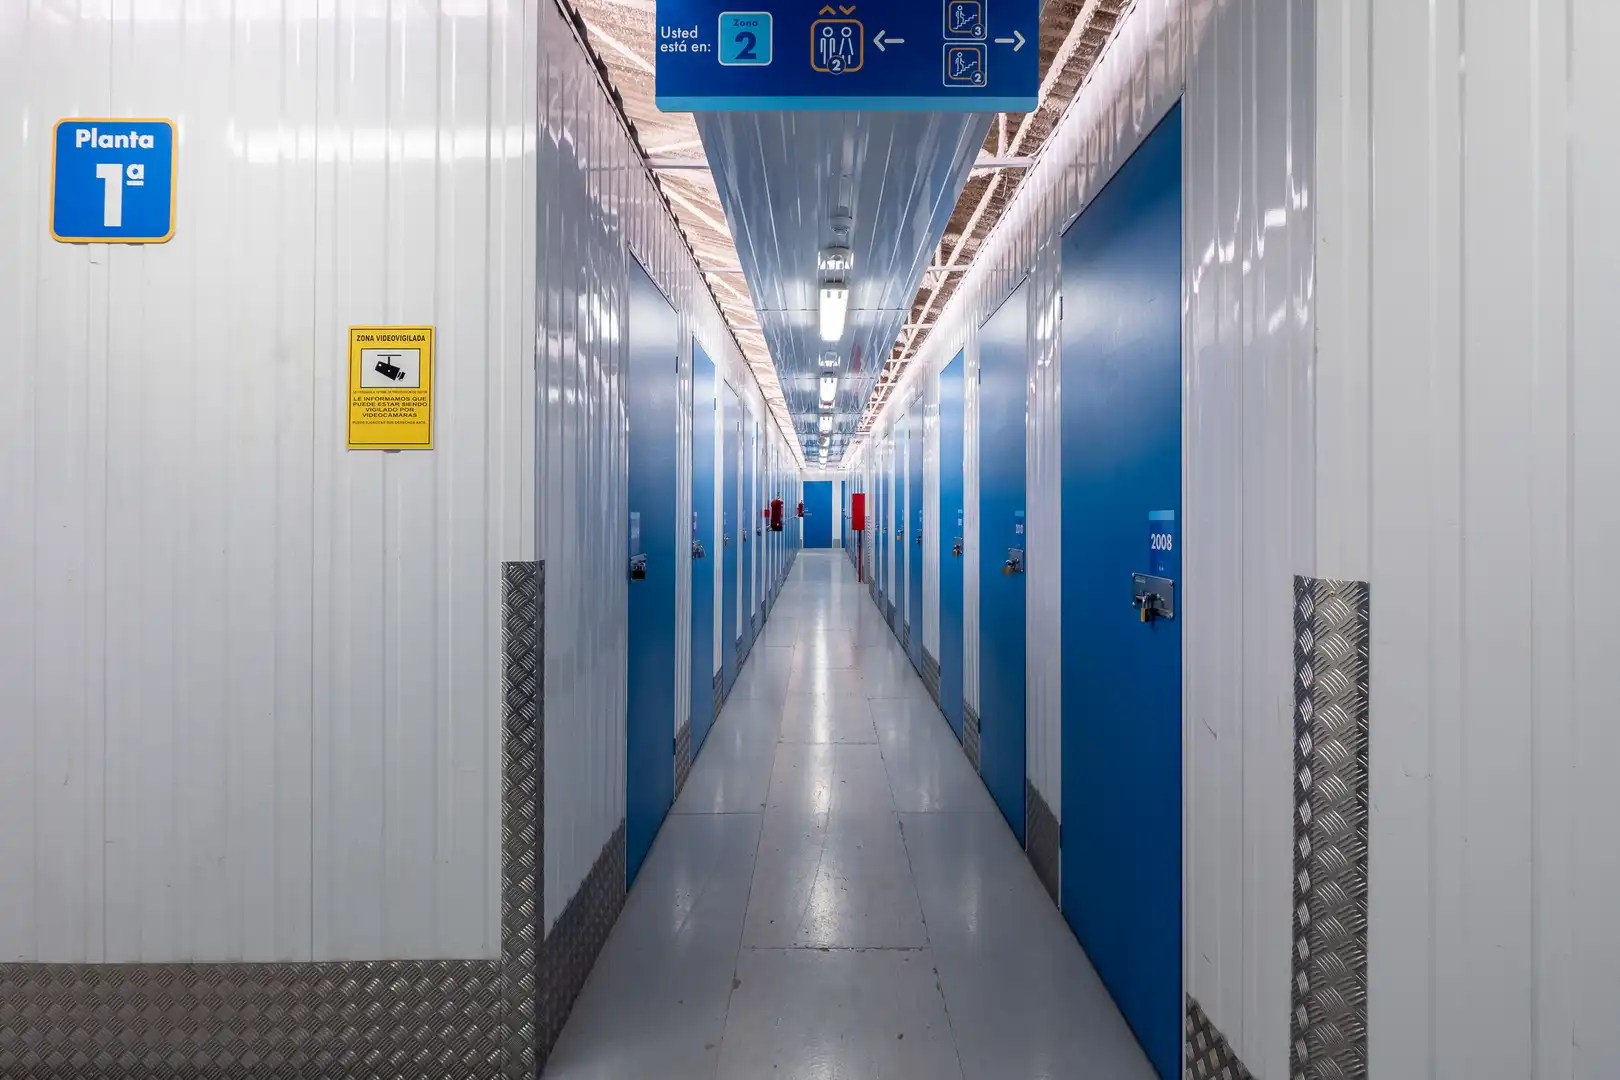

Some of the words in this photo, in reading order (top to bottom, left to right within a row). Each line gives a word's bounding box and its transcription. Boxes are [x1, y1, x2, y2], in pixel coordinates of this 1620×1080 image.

[733, 18, 758, 27] Zona
[661, 25, 698, 39] Usted
[975, 26, 982, 35] 3
[660, 40, 687, 52] está
[691, 43, 711, 52] en:
[733, 31, 757, 60] 2
[831, 60, 841, 71] 2
[975, 73, 982, 82] 2
[75, 128, 154, 149] Planta
[1151, 533, 1172, 551] 2008
